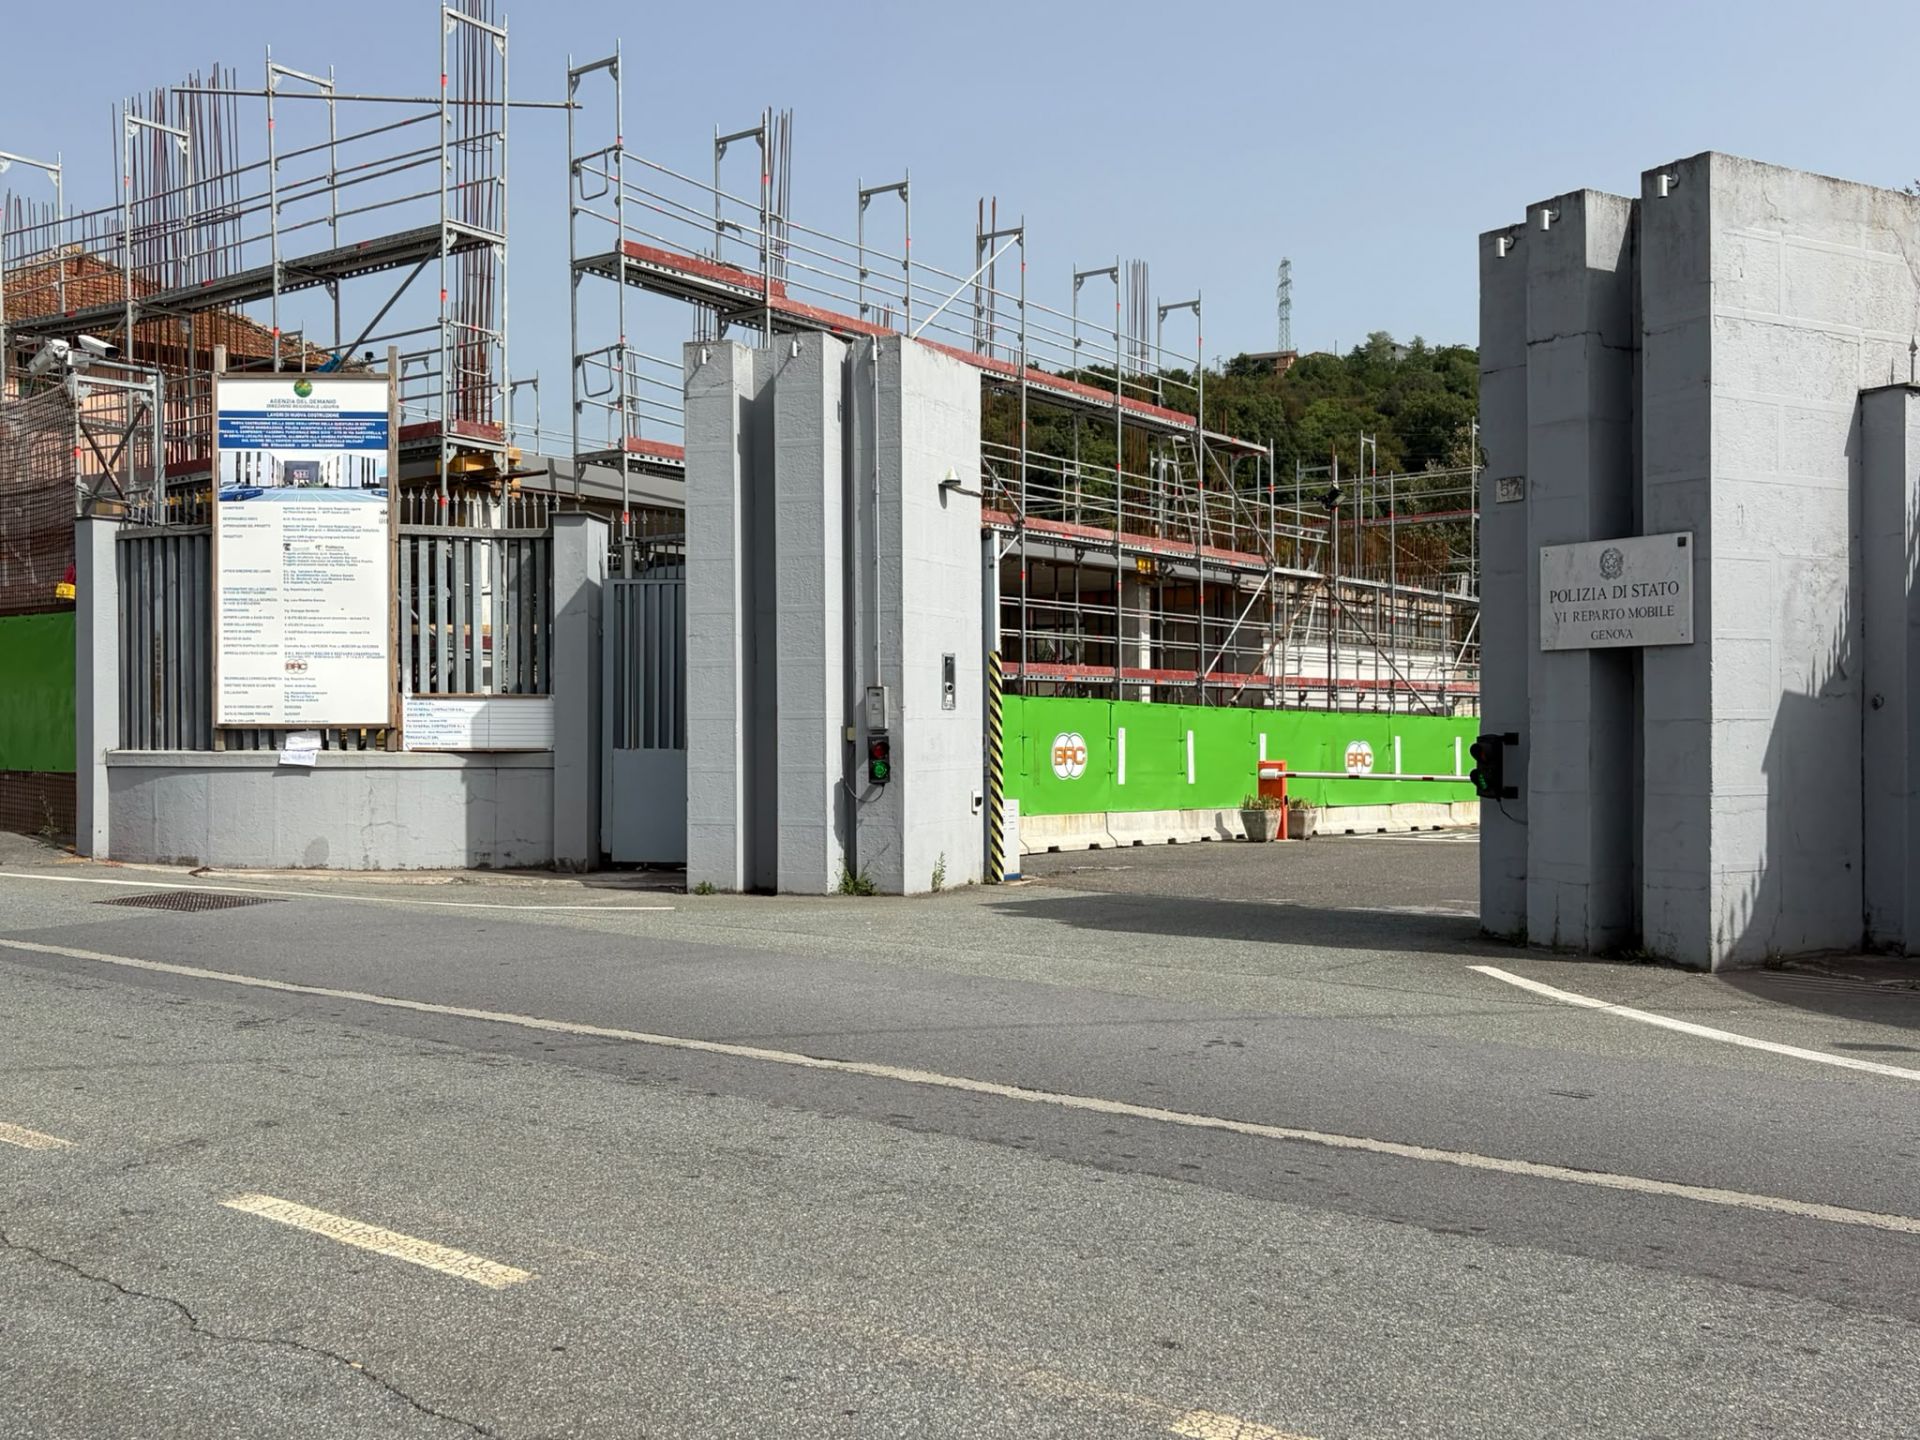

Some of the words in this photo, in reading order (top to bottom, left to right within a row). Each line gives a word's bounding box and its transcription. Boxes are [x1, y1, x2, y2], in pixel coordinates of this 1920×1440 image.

[1549, 586, 1607, 604] POLIZIA
[1612, 584, 1627, 599] DI
[1631, 580, 1679, 598] STATO
[1554, 610, 1567, 625] VI
[1573, 607, 1625, 623] REPARTO
[1628, 605, 1675, 619] MOBILE
[1590, 629, 1634, 641] GENOVA
